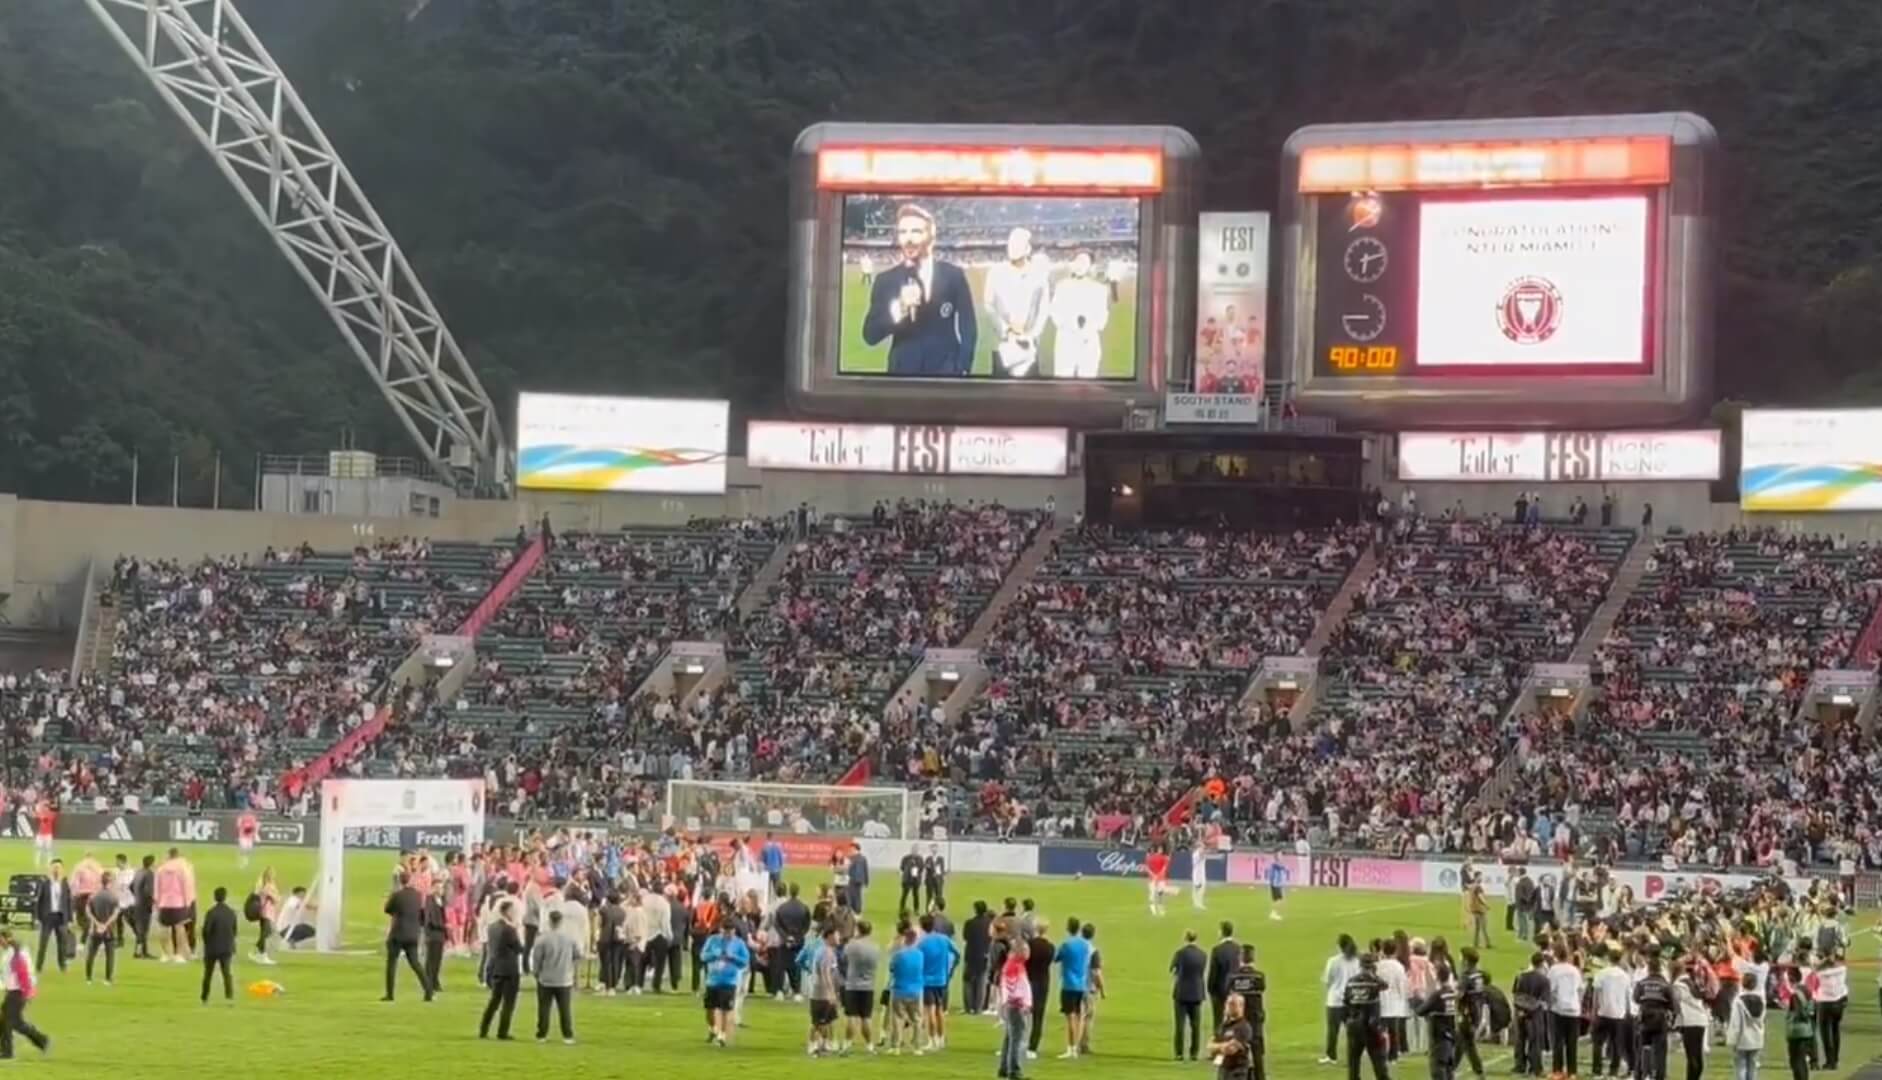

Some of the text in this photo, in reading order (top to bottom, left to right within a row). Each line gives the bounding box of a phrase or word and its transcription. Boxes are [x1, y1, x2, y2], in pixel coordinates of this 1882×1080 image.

[1222, 226, 1255, 251] FEST
[1329, 346, 1398, 368] 90:00
[1174, 395, 1253, 406] SOUTH STAND
[893, 425, 955, 473] FEST
[1545, 433, 1606, 481] FEST
[416, 830, 463, 846] Fracht
[1309, 857, 1351, 888] FEST
